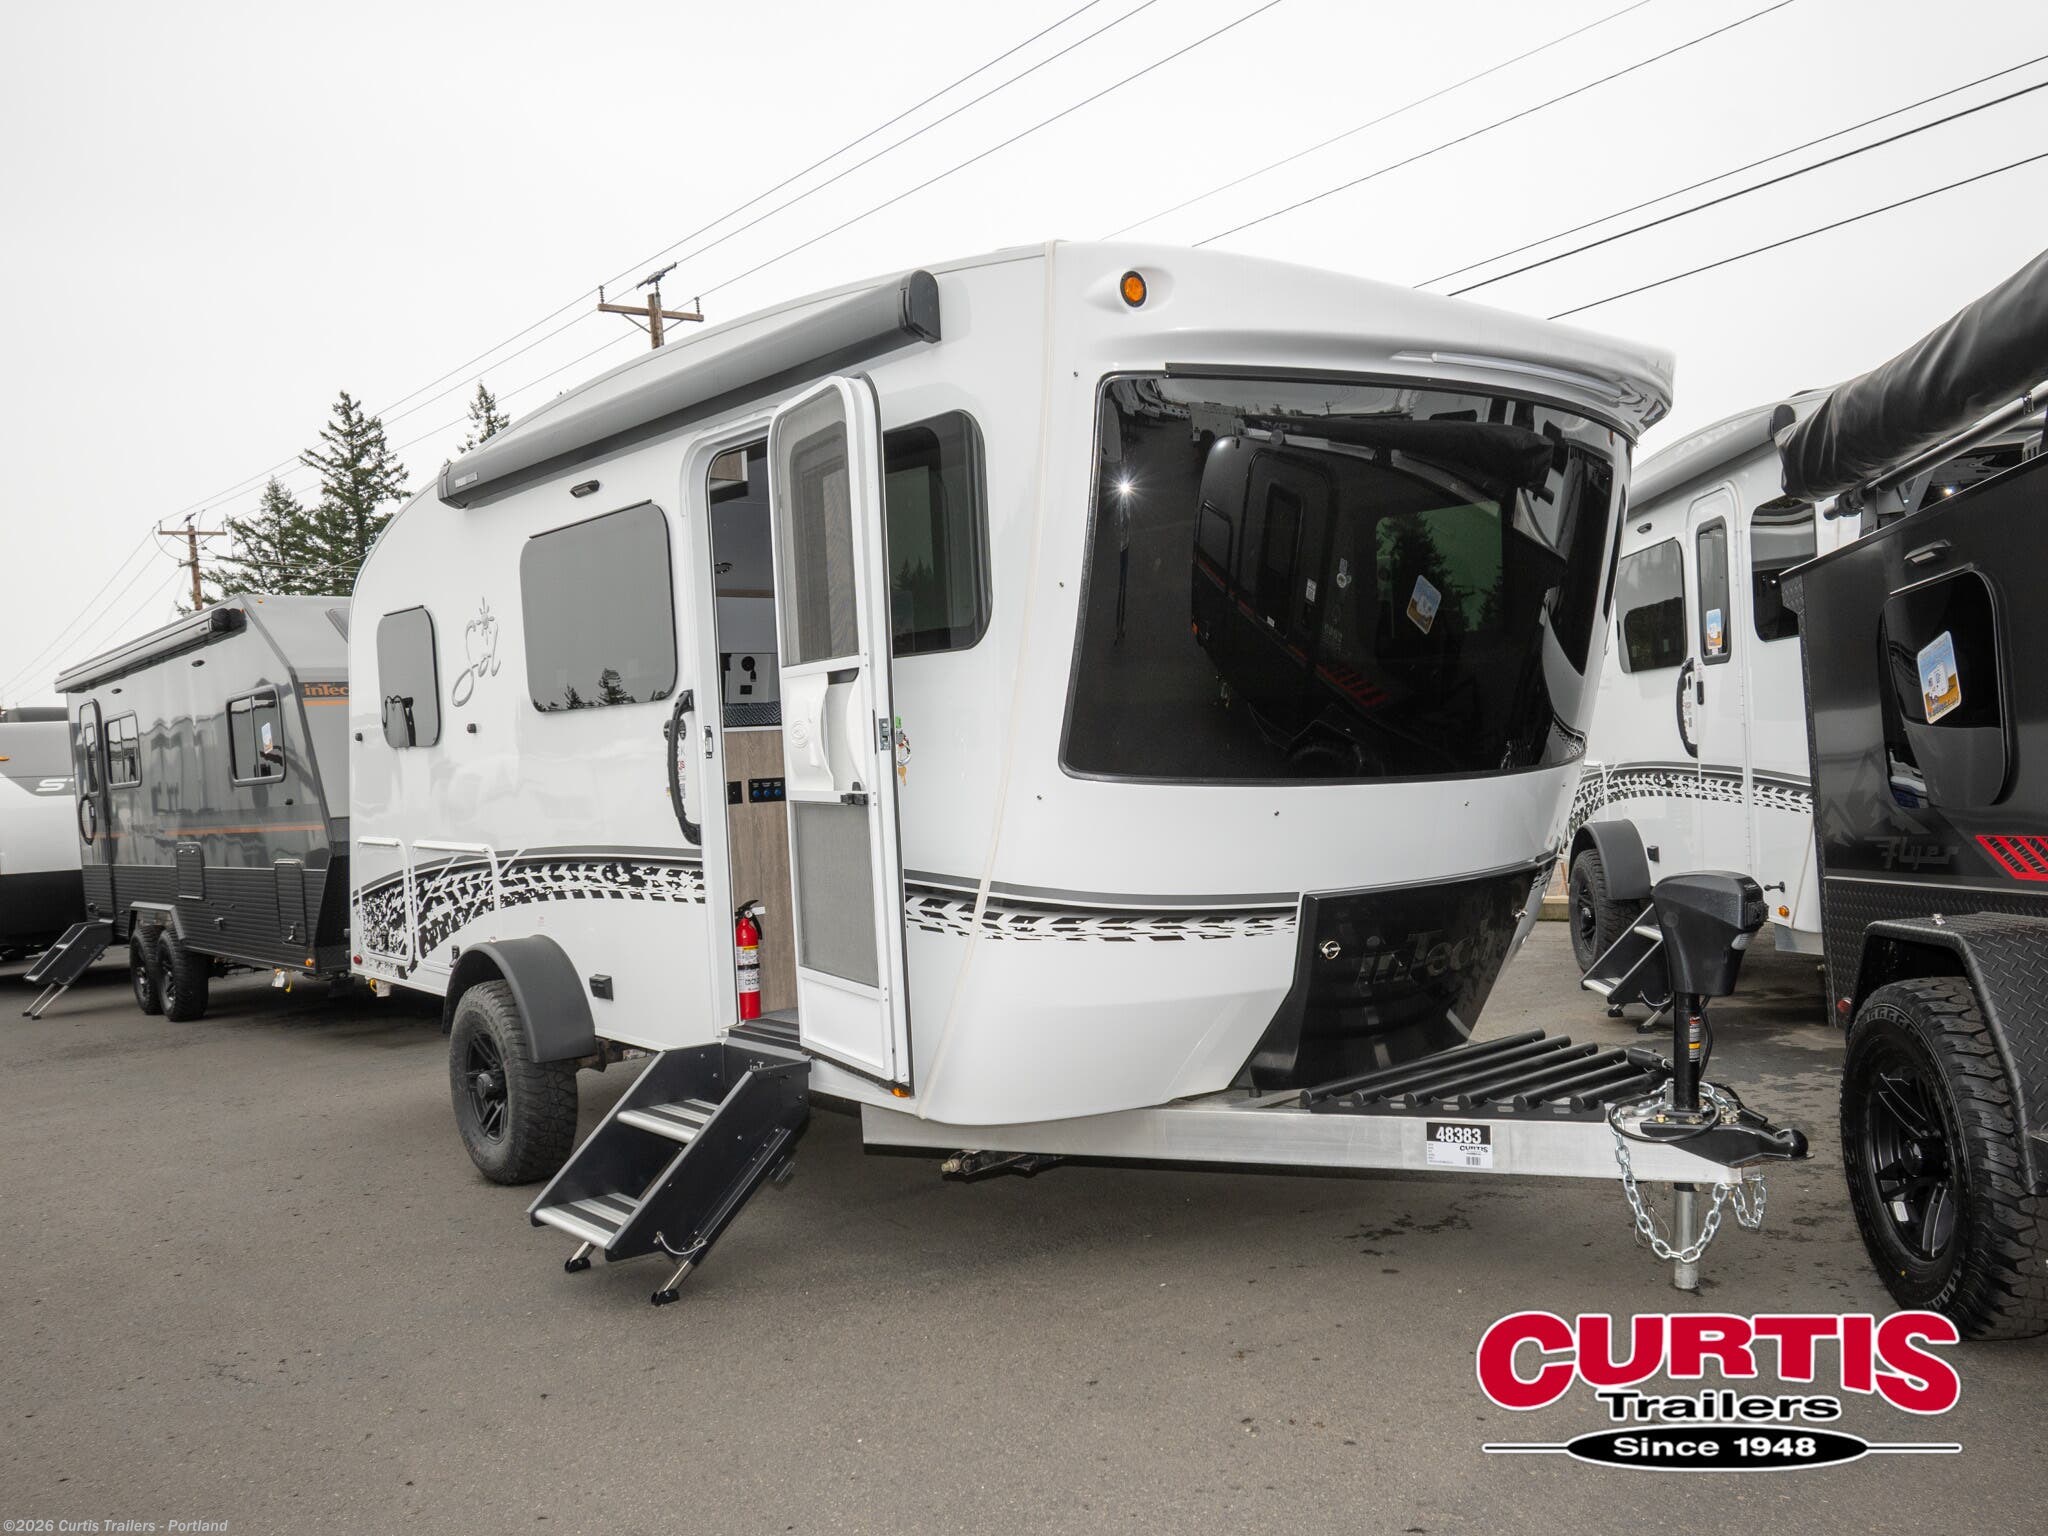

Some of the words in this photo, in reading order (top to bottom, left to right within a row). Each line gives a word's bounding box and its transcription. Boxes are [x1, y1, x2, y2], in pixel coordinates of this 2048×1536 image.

[36, 778, 74, 791] S
[1864, 836, 1960, 871] Flyer
[1436, 1126, 1482, 1144] 48383
[1459, 1145, 1488, 1153] CURTIS
